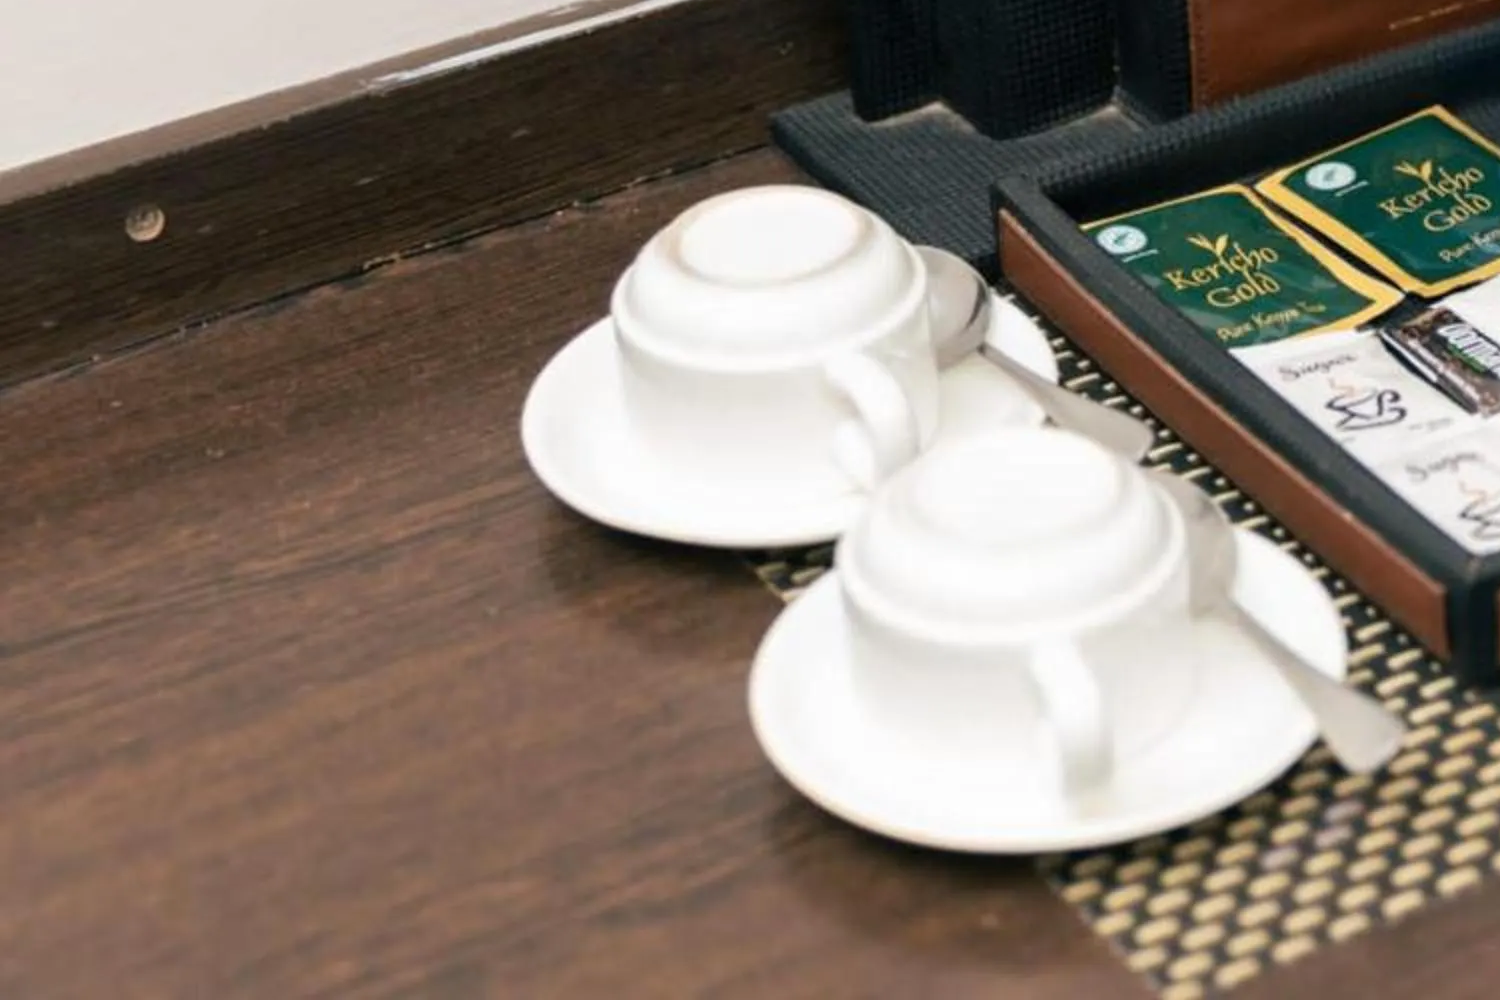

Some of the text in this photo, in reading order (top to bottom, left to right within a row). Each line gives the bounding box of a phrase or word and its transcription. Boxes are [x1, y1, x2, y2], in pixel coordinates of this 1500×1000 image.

[1378, 166, 1487, 219] Kericho
[1423, 191, 1494, 232] Gold
[1163, 242, 1279, 292] Kericho
[1207, 269, 1281, 308] Gold
[1277, 353, 1361, 383] Sugar
